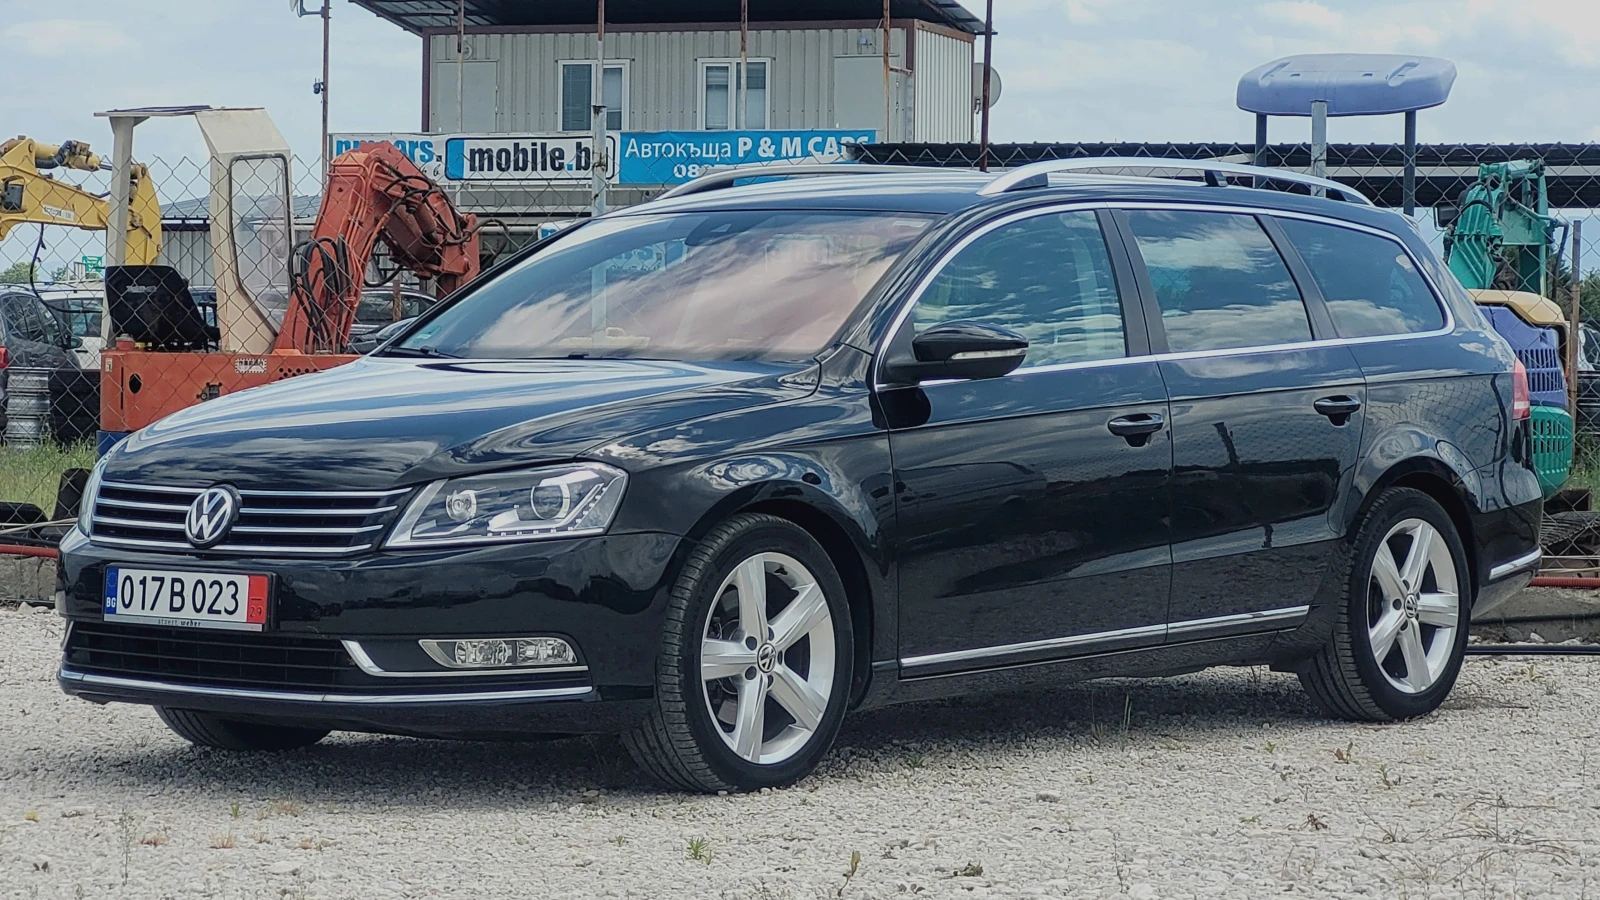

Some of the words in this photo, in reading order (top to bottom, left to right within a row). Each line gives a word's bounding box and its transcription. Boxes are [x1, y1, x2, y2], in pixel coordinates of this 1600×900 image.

[469, 141, 609, 173] mobile.b
[625, 137, 731, 161] Автокъща
[738, 136, 753, 157] P
[757, 136, 775, 157] &
[781, 136, 802, 157] M
[106, 597, 116, 608] BG
[250, 606, 262, 618] 29
